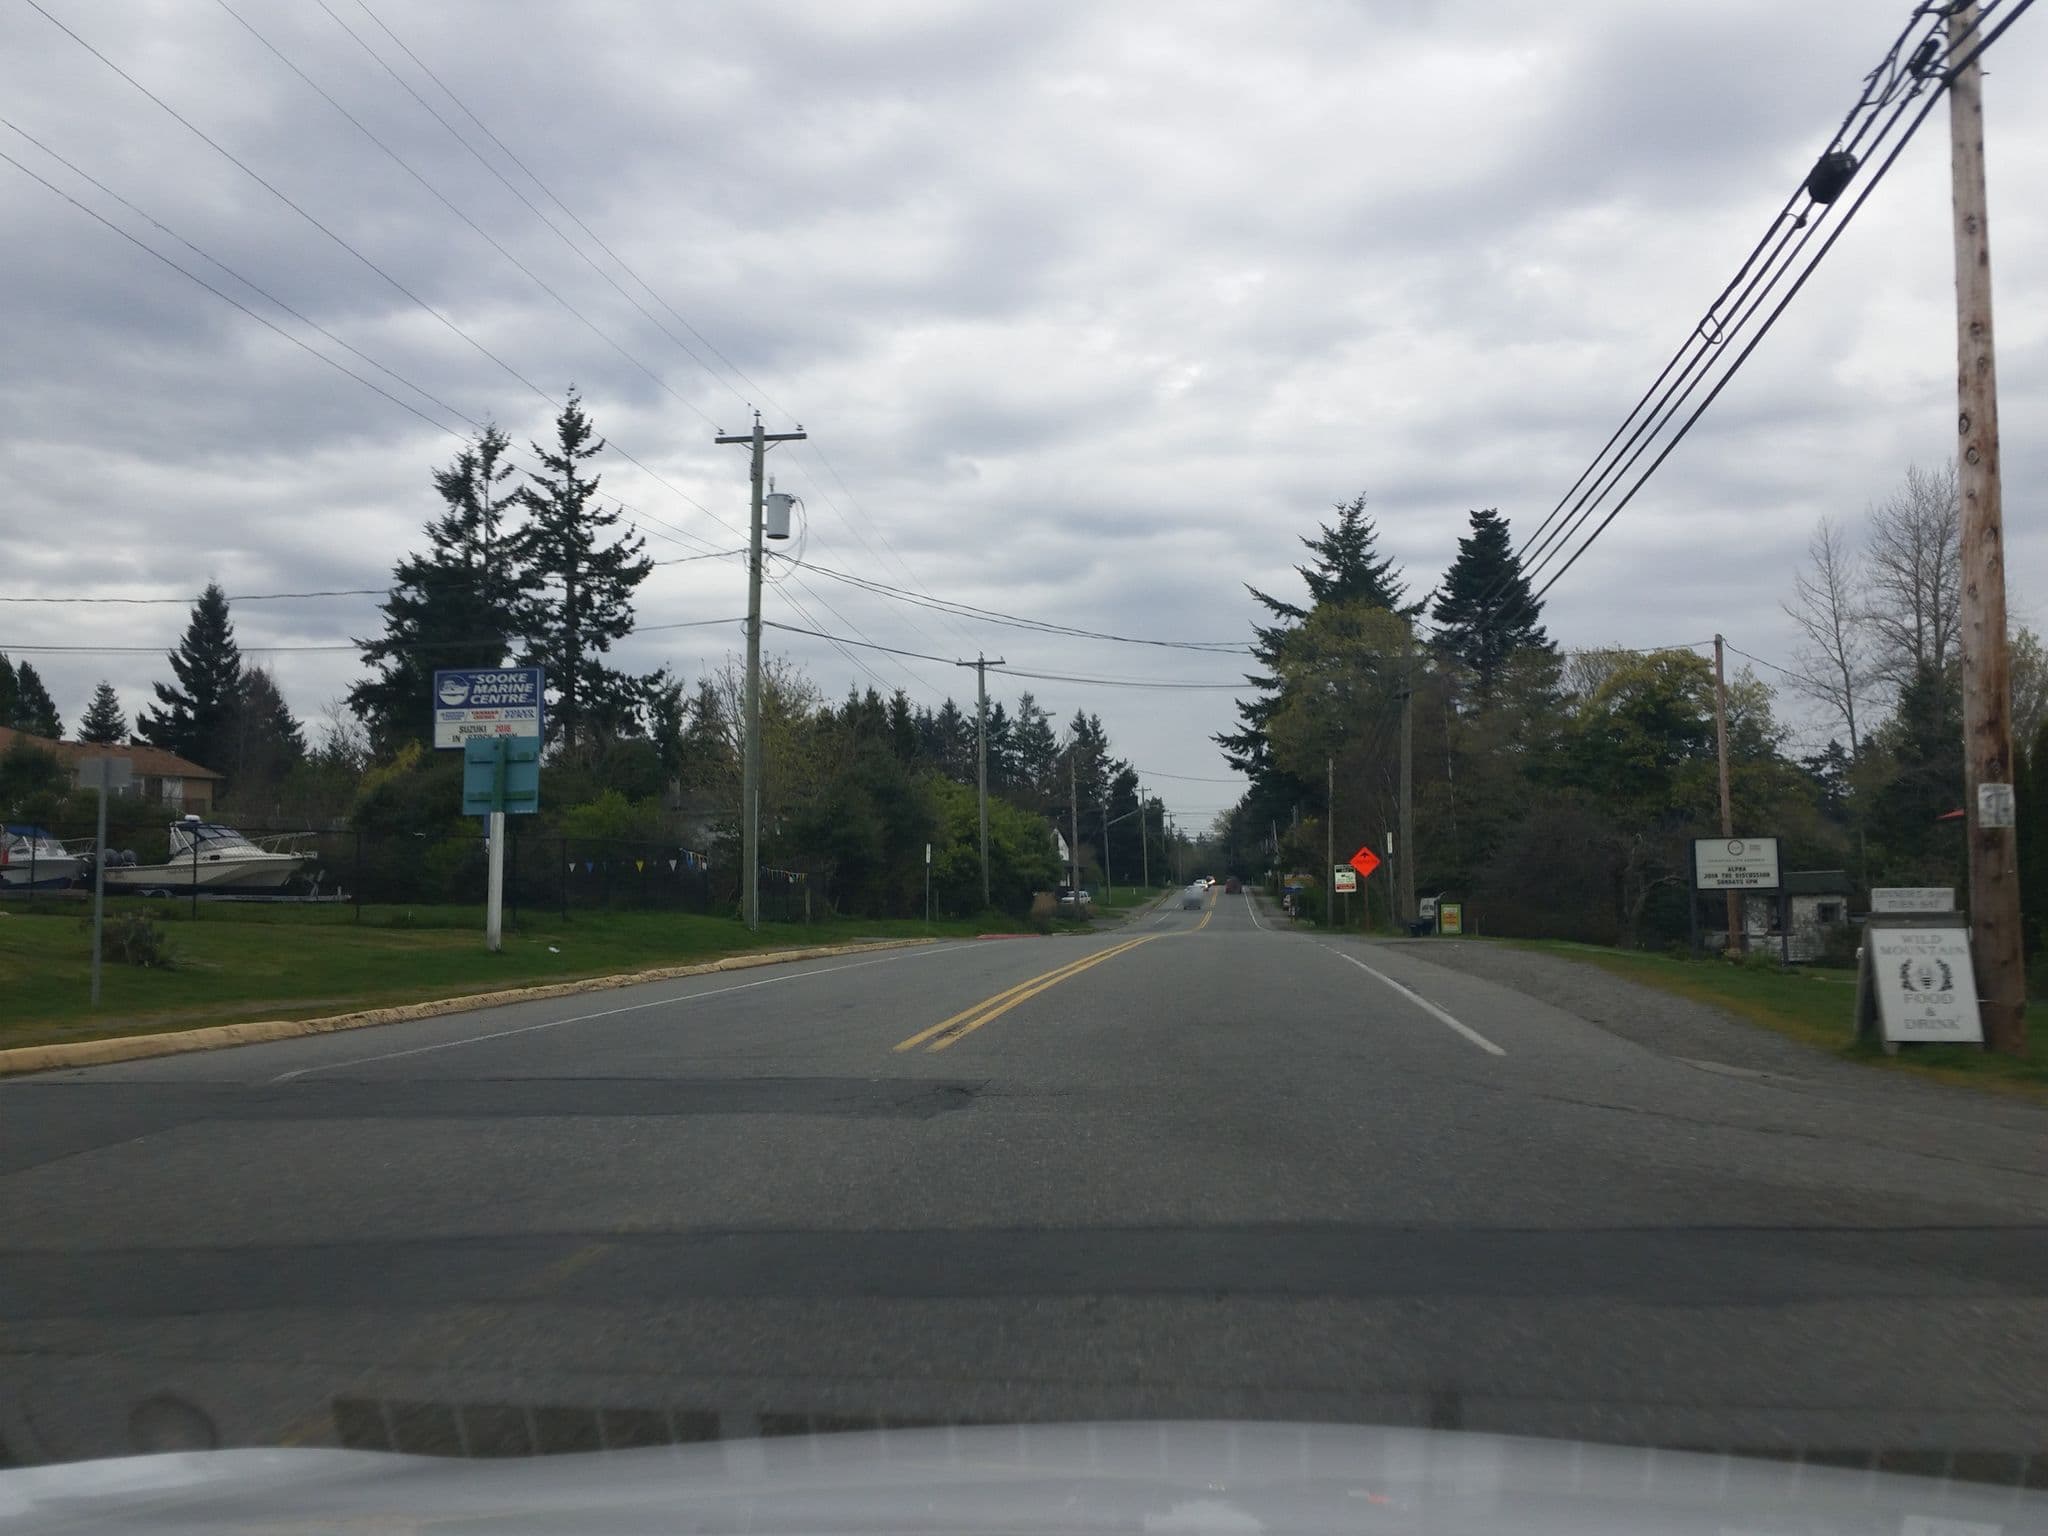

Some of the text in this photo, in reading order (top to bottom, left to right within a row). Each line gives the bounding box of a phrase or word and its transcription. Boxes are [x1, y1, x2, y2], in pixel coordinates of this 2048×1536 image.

[476, 673, 528, 684] SOOKE
[473, 683, 534, 694] MARINE
[470, 693, 528, 705] CENTRE
[459, 725, 487, 734] SUZUKI
[1901, 934, 1942, 945] WILD
[1879, 945, 1968, 956] MOUNTAIN
[1903, 993, 1954, 1005] FOOD
